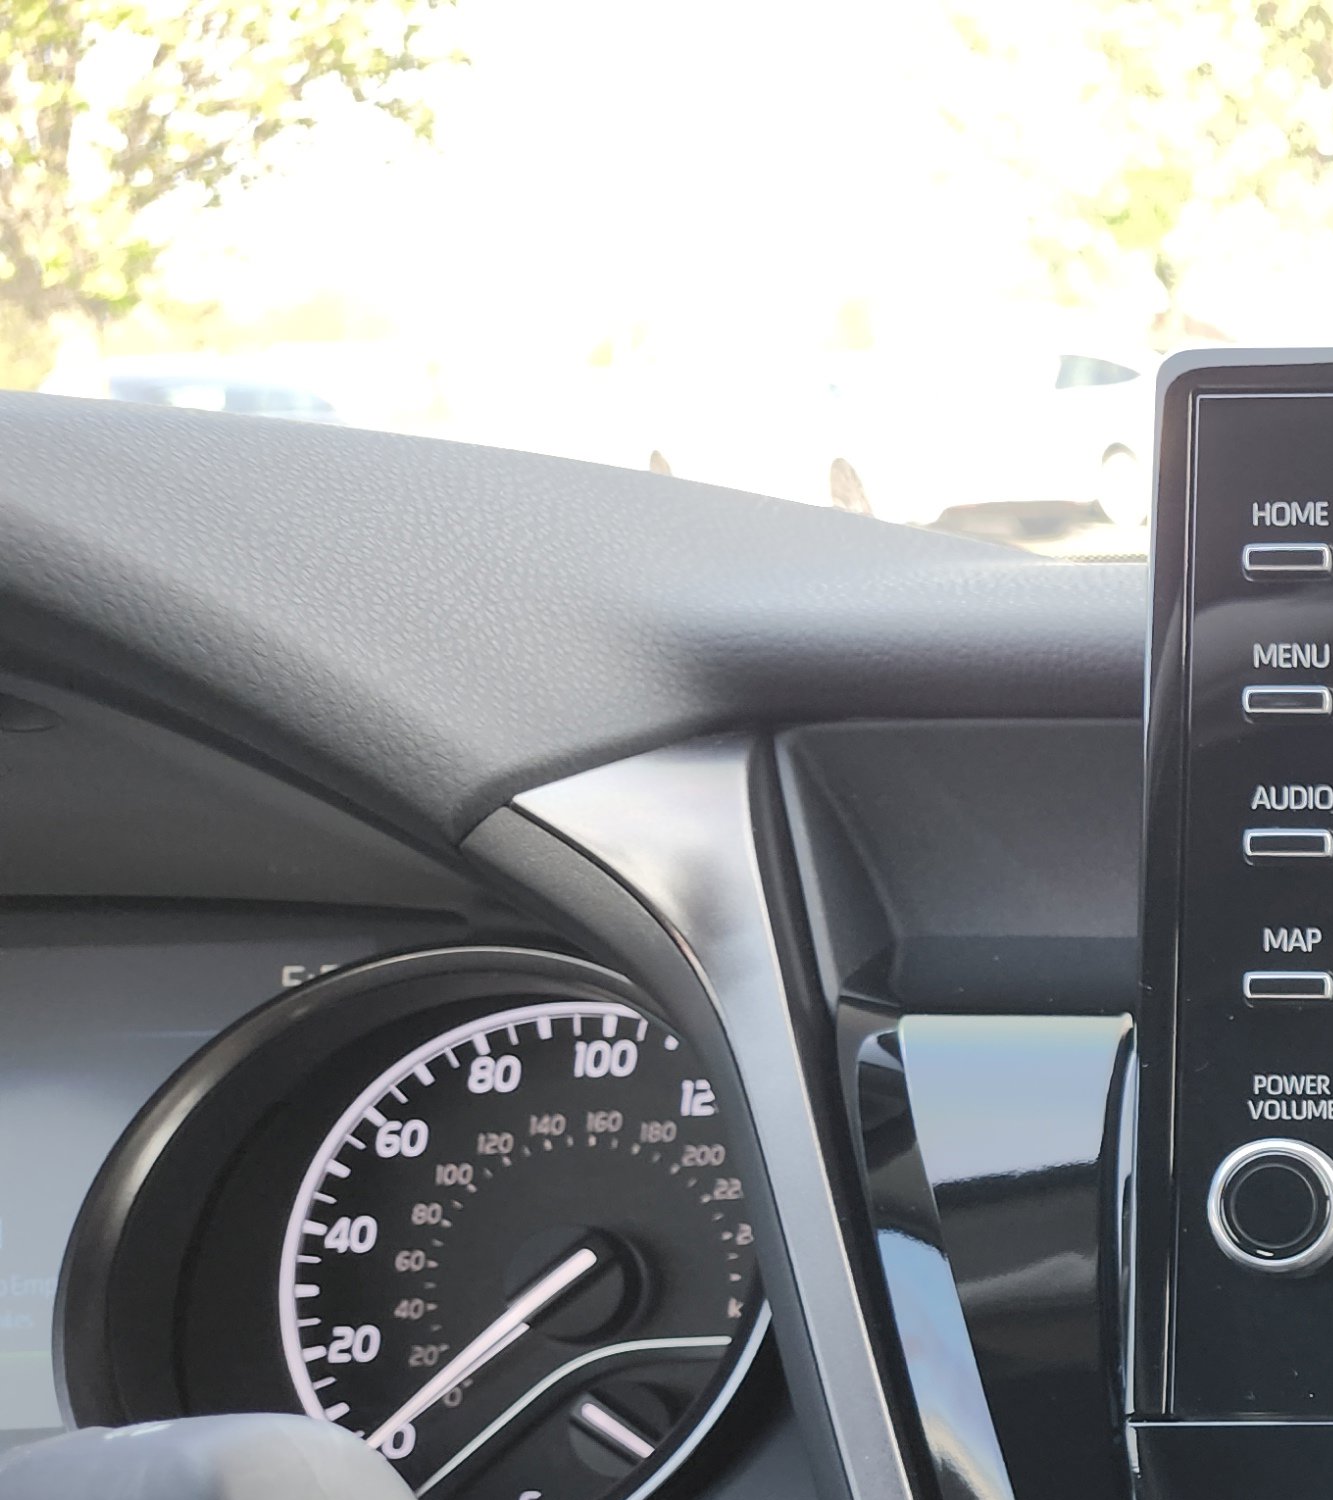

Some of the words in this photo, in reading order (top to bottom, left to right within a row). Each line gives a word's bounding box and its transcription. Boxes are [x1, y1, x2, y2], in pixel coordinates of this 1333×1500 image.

[1251, 501, 1330, 526] HOME
[1252, 643, 1331, 669] MENU
[1250, 786, 1333, 811] AUDIO
[1262, 928, 1323, 953] MAP
[573, 1039, 638, 1079] 100
[468, 1055, 522, 1093] 80
[1253, 1074, 1332, 1097] POWER
[680, 1079, 720, 1116] 12
[528, 1112, 567, 1138] 140
[585, 1110, 624, 1134] 160
[639, 1119, 678, 1144] 180
[374, 1119, 430, 1158] 60
[476, 1132, 515, 1156] 120
[680, 1143, 727, 1167] 200
[434, 1162, 475, 1187] 100
[711, 1177, 746, 1201] 22
[410, 1202, 443, 1226] 80
[324, 1215, 378, 1254] 40
[394, 1249, 427, 1273] 60
[393, 1298, 425, 1321] 40
[326, 1324, 381, 1364] 20
[408, 1345, 440, 1368] 20
